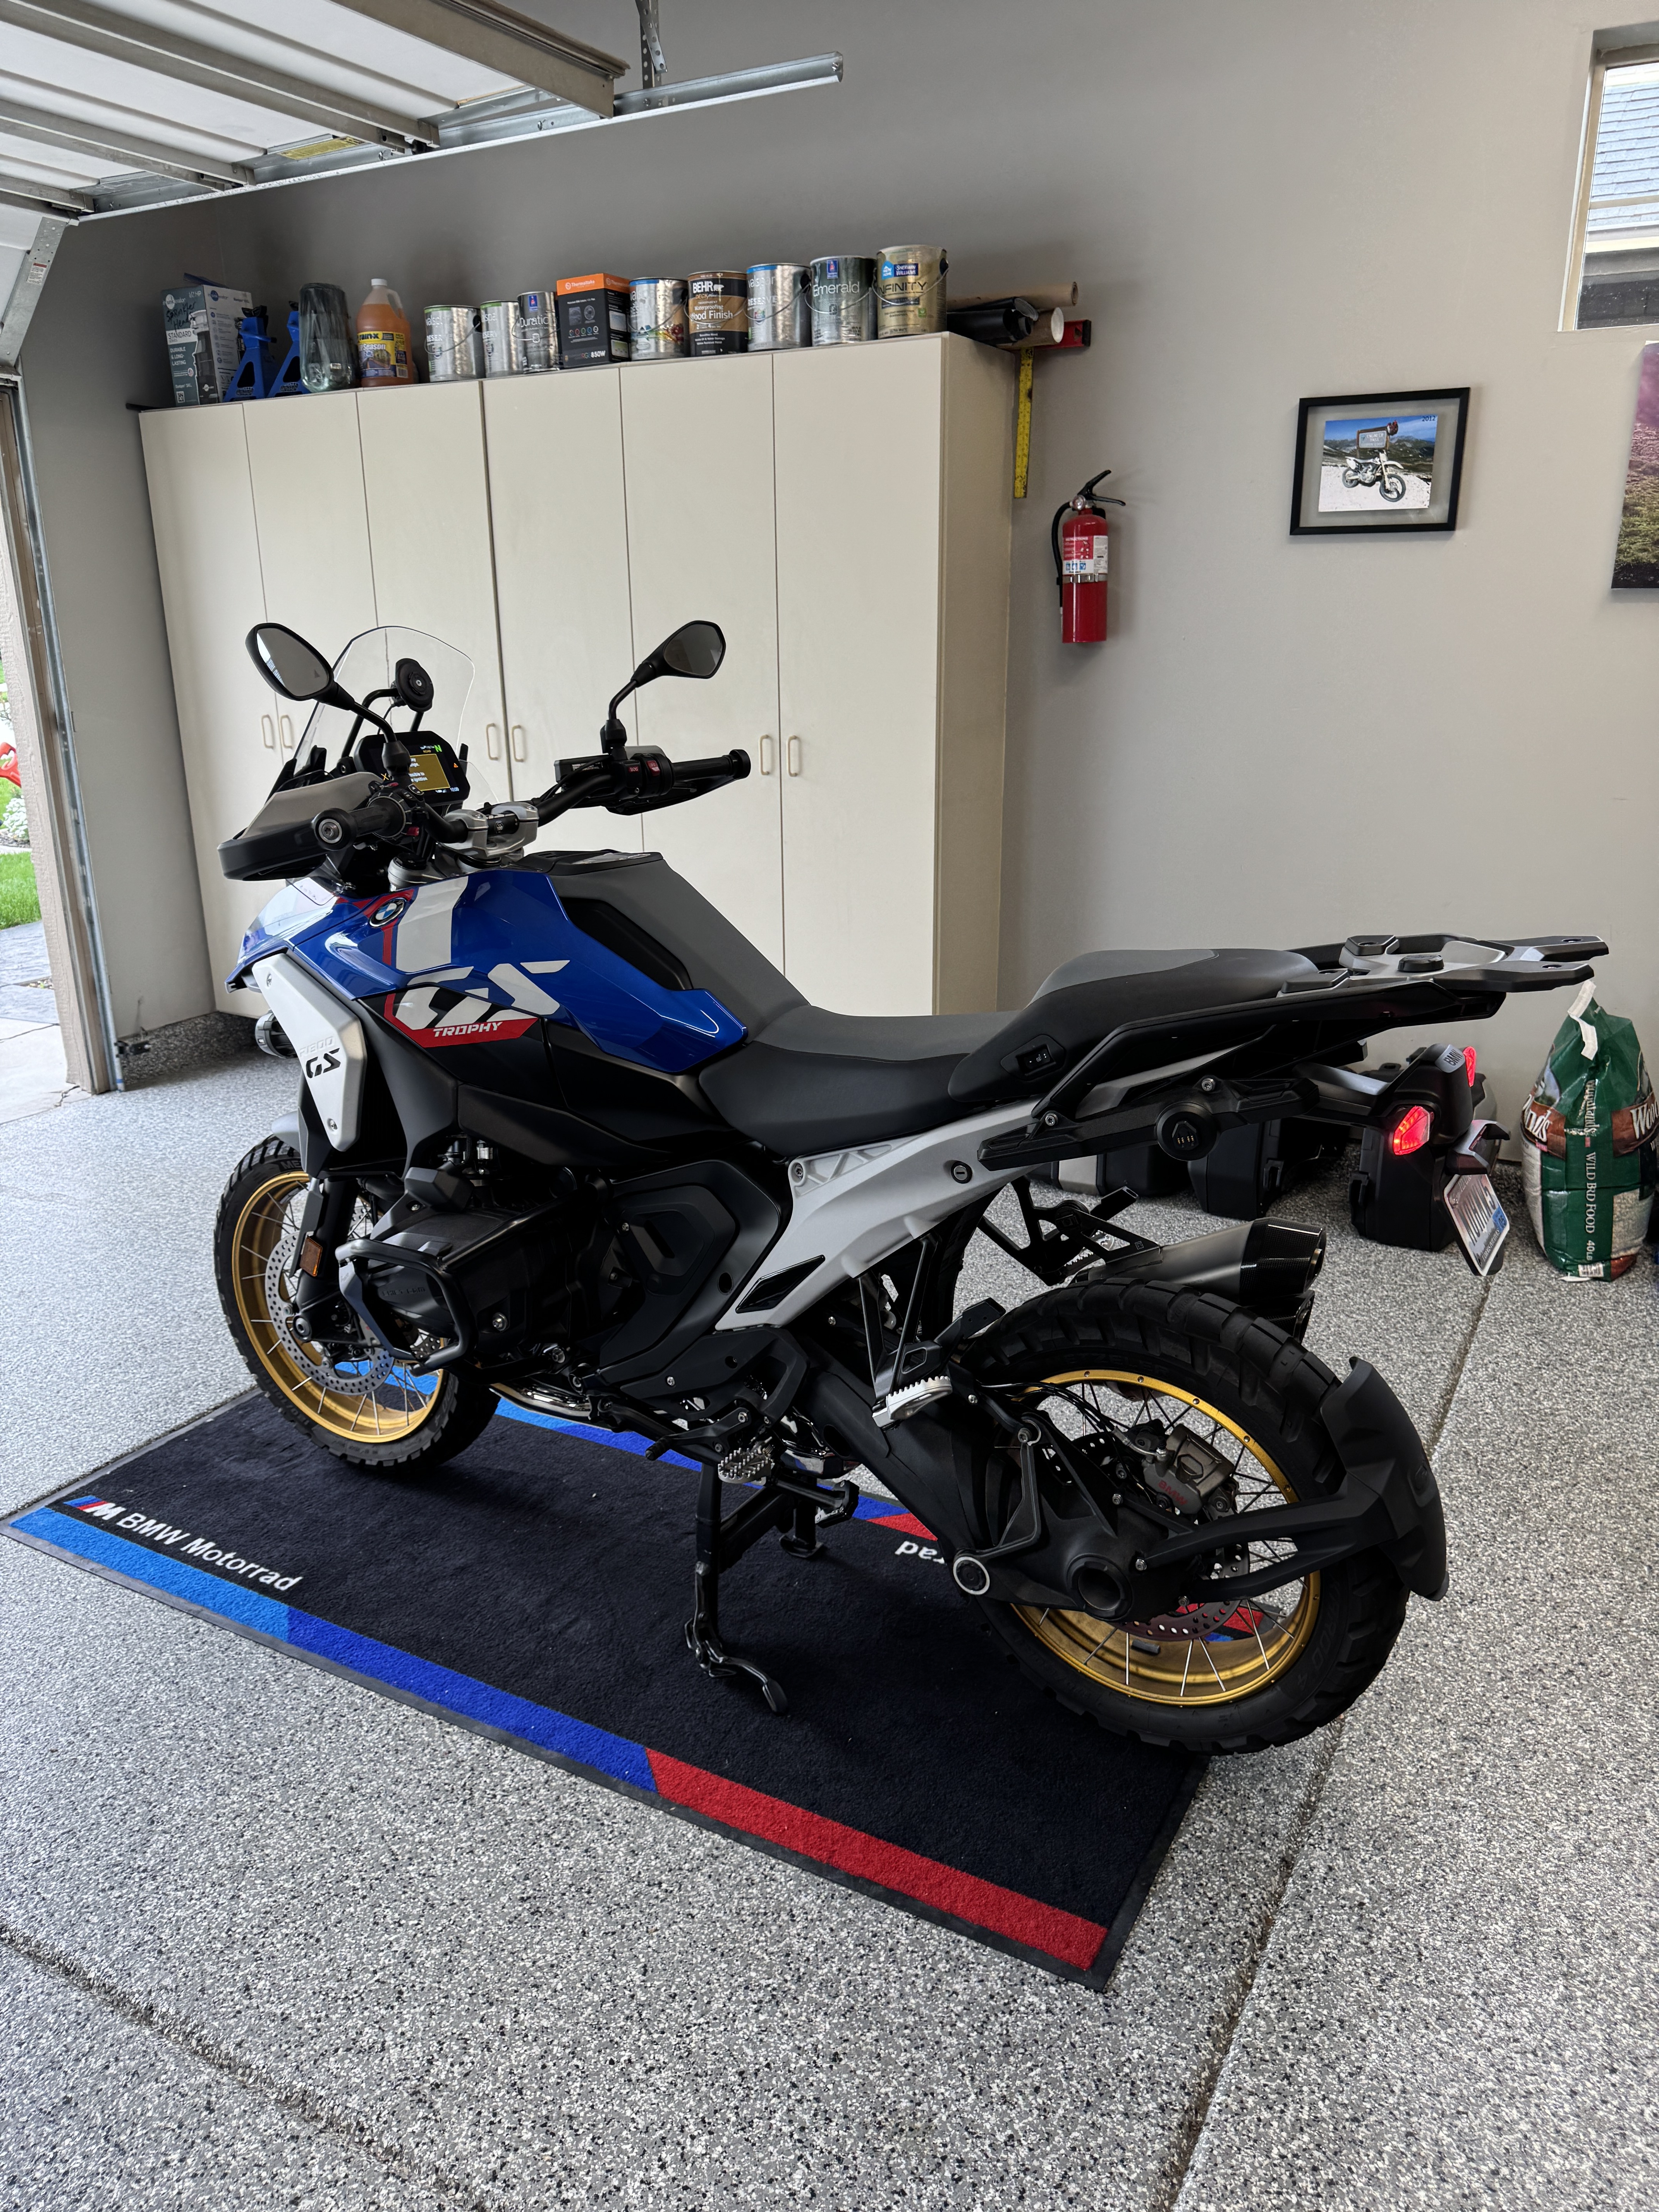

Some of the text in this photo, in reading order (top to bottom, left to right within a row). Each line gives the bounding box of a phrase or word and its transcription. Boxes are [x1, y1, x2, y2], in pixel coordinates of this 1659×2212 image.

[692, 281, 713, 294] BEHR
[813, 281, 860, 297] Emerald
[879, 282, 927, 294] NFINITY
[709, 310, 733, 319] Finish
[168, 330, 191, 339] STANDARD
[433, 1021, 503, 1037] TROPHY
[305, 1048, 342, 1079] GS
[1443, 1049, 1463, 1066] BMW
[1586, 1151, 1596, 1181] WILD
[1585, 1203, 1597, 1234] FOOD
[117, 1513, 190, 1545] BMW
[180, 1538, 304, 1592] Motorrad
